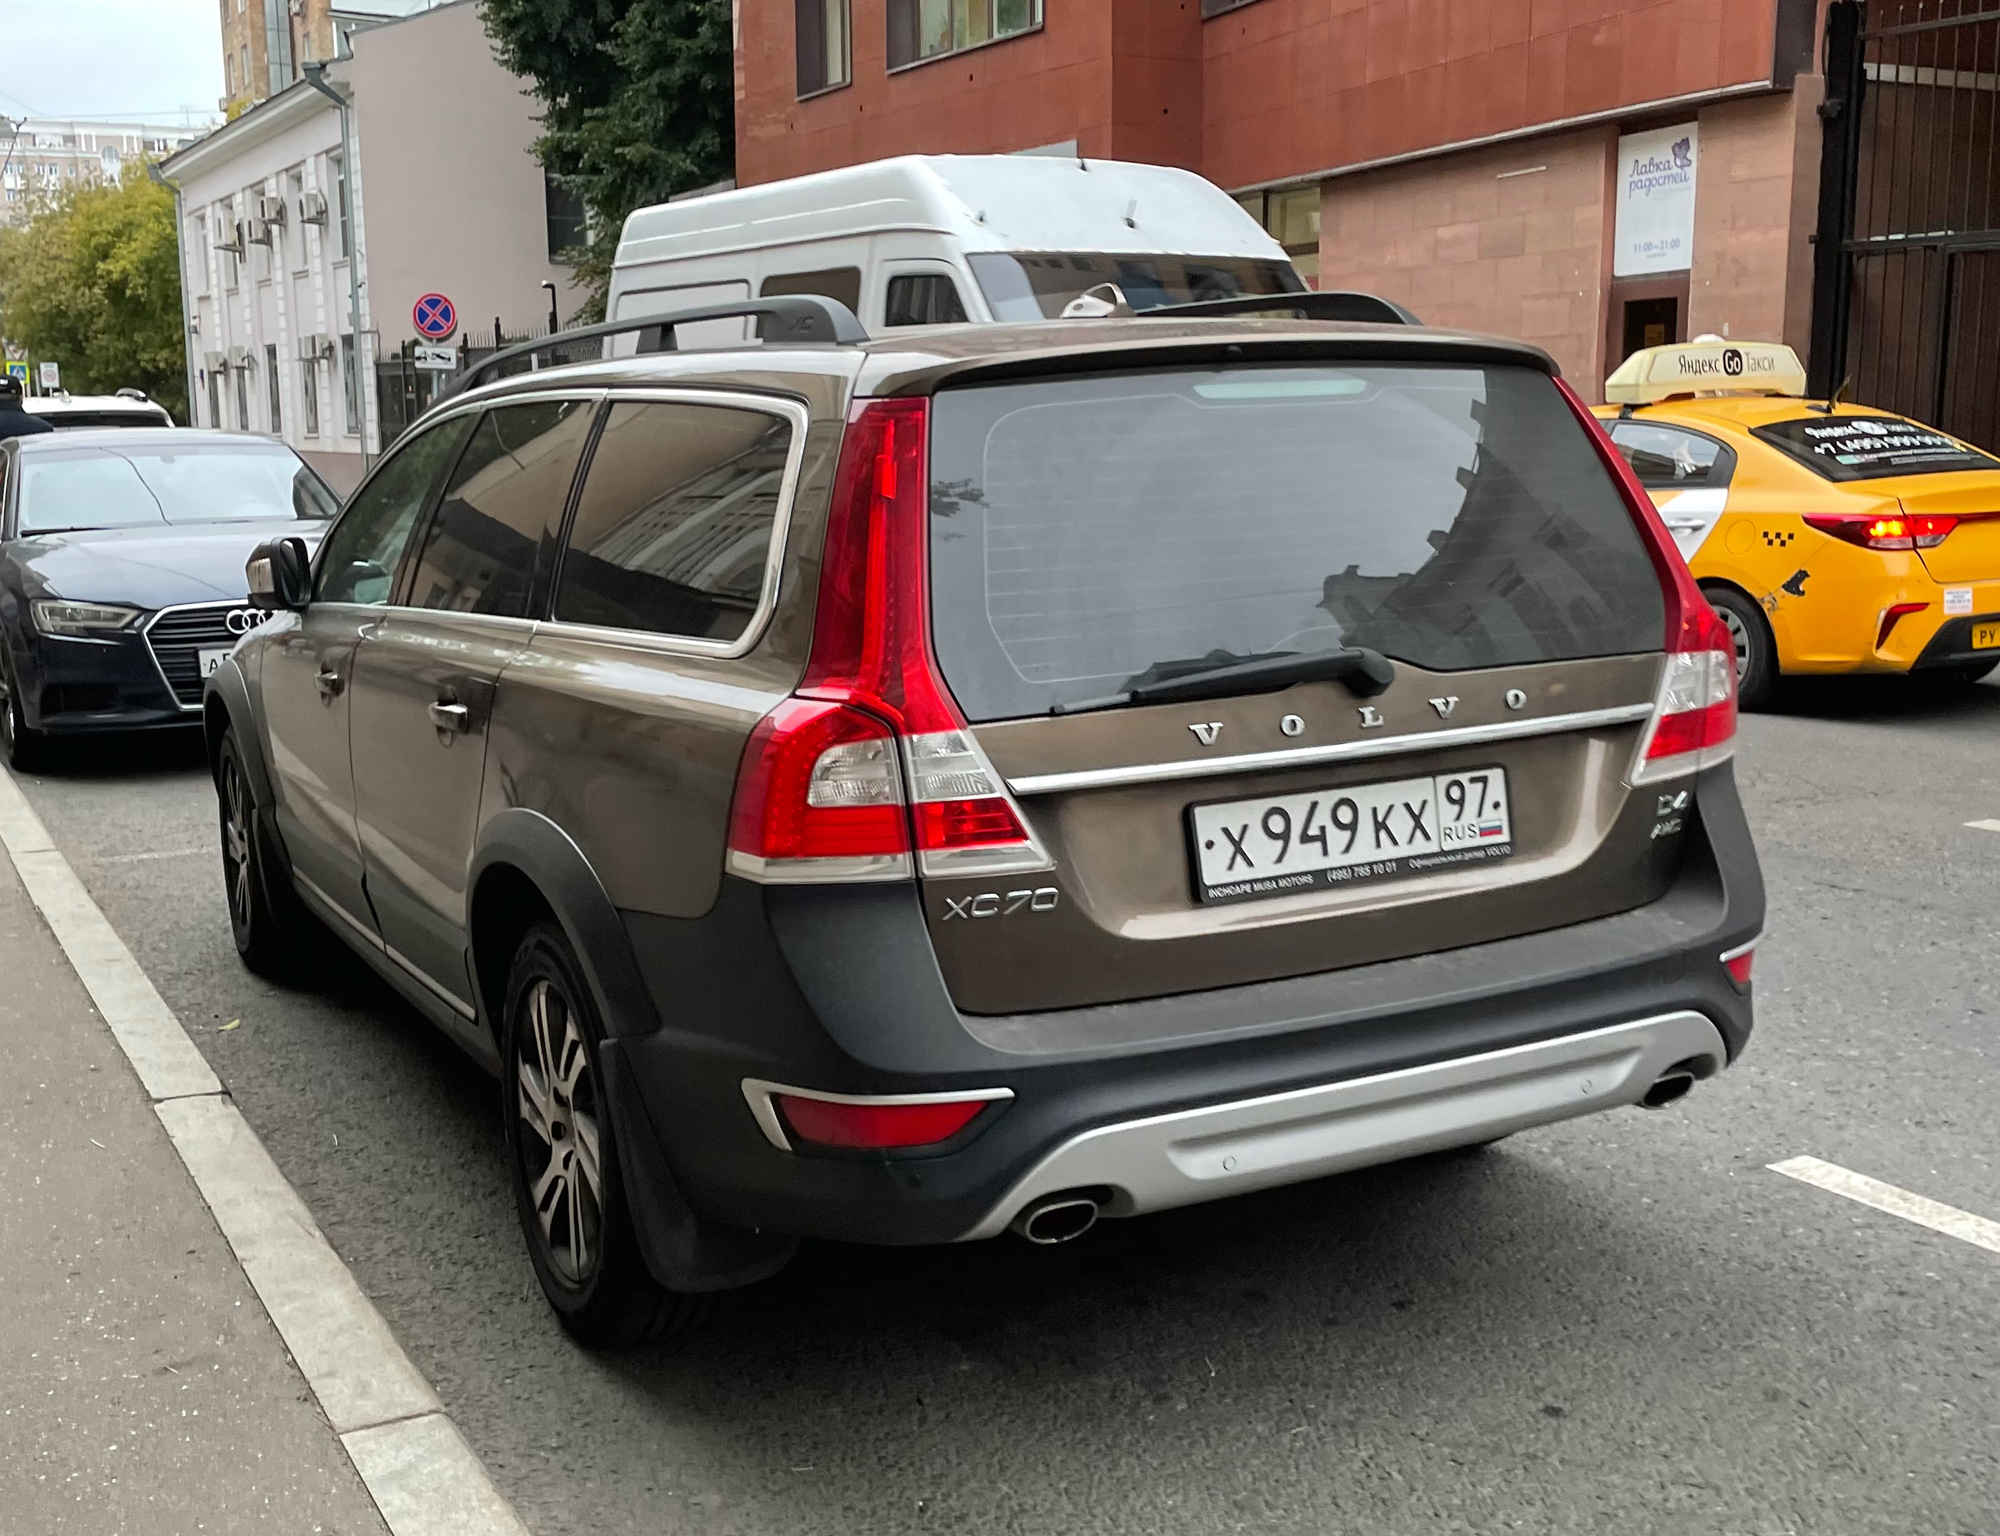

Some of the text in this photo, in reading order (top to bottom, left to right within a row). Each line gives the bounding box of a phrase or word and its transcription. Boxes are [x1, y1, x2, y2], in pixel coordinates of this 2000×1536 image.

[1629, 156, 1673, 178] Лавка
[1629, 170, 1690, 200] радостей
[1678, 350, 1775, 376] Яндекс Go Такси
[1189, 688, 1527, 746] VOLVO
[1445, 775, 1488, 821] 97
[1443, 823, 1477, 842] RUS
